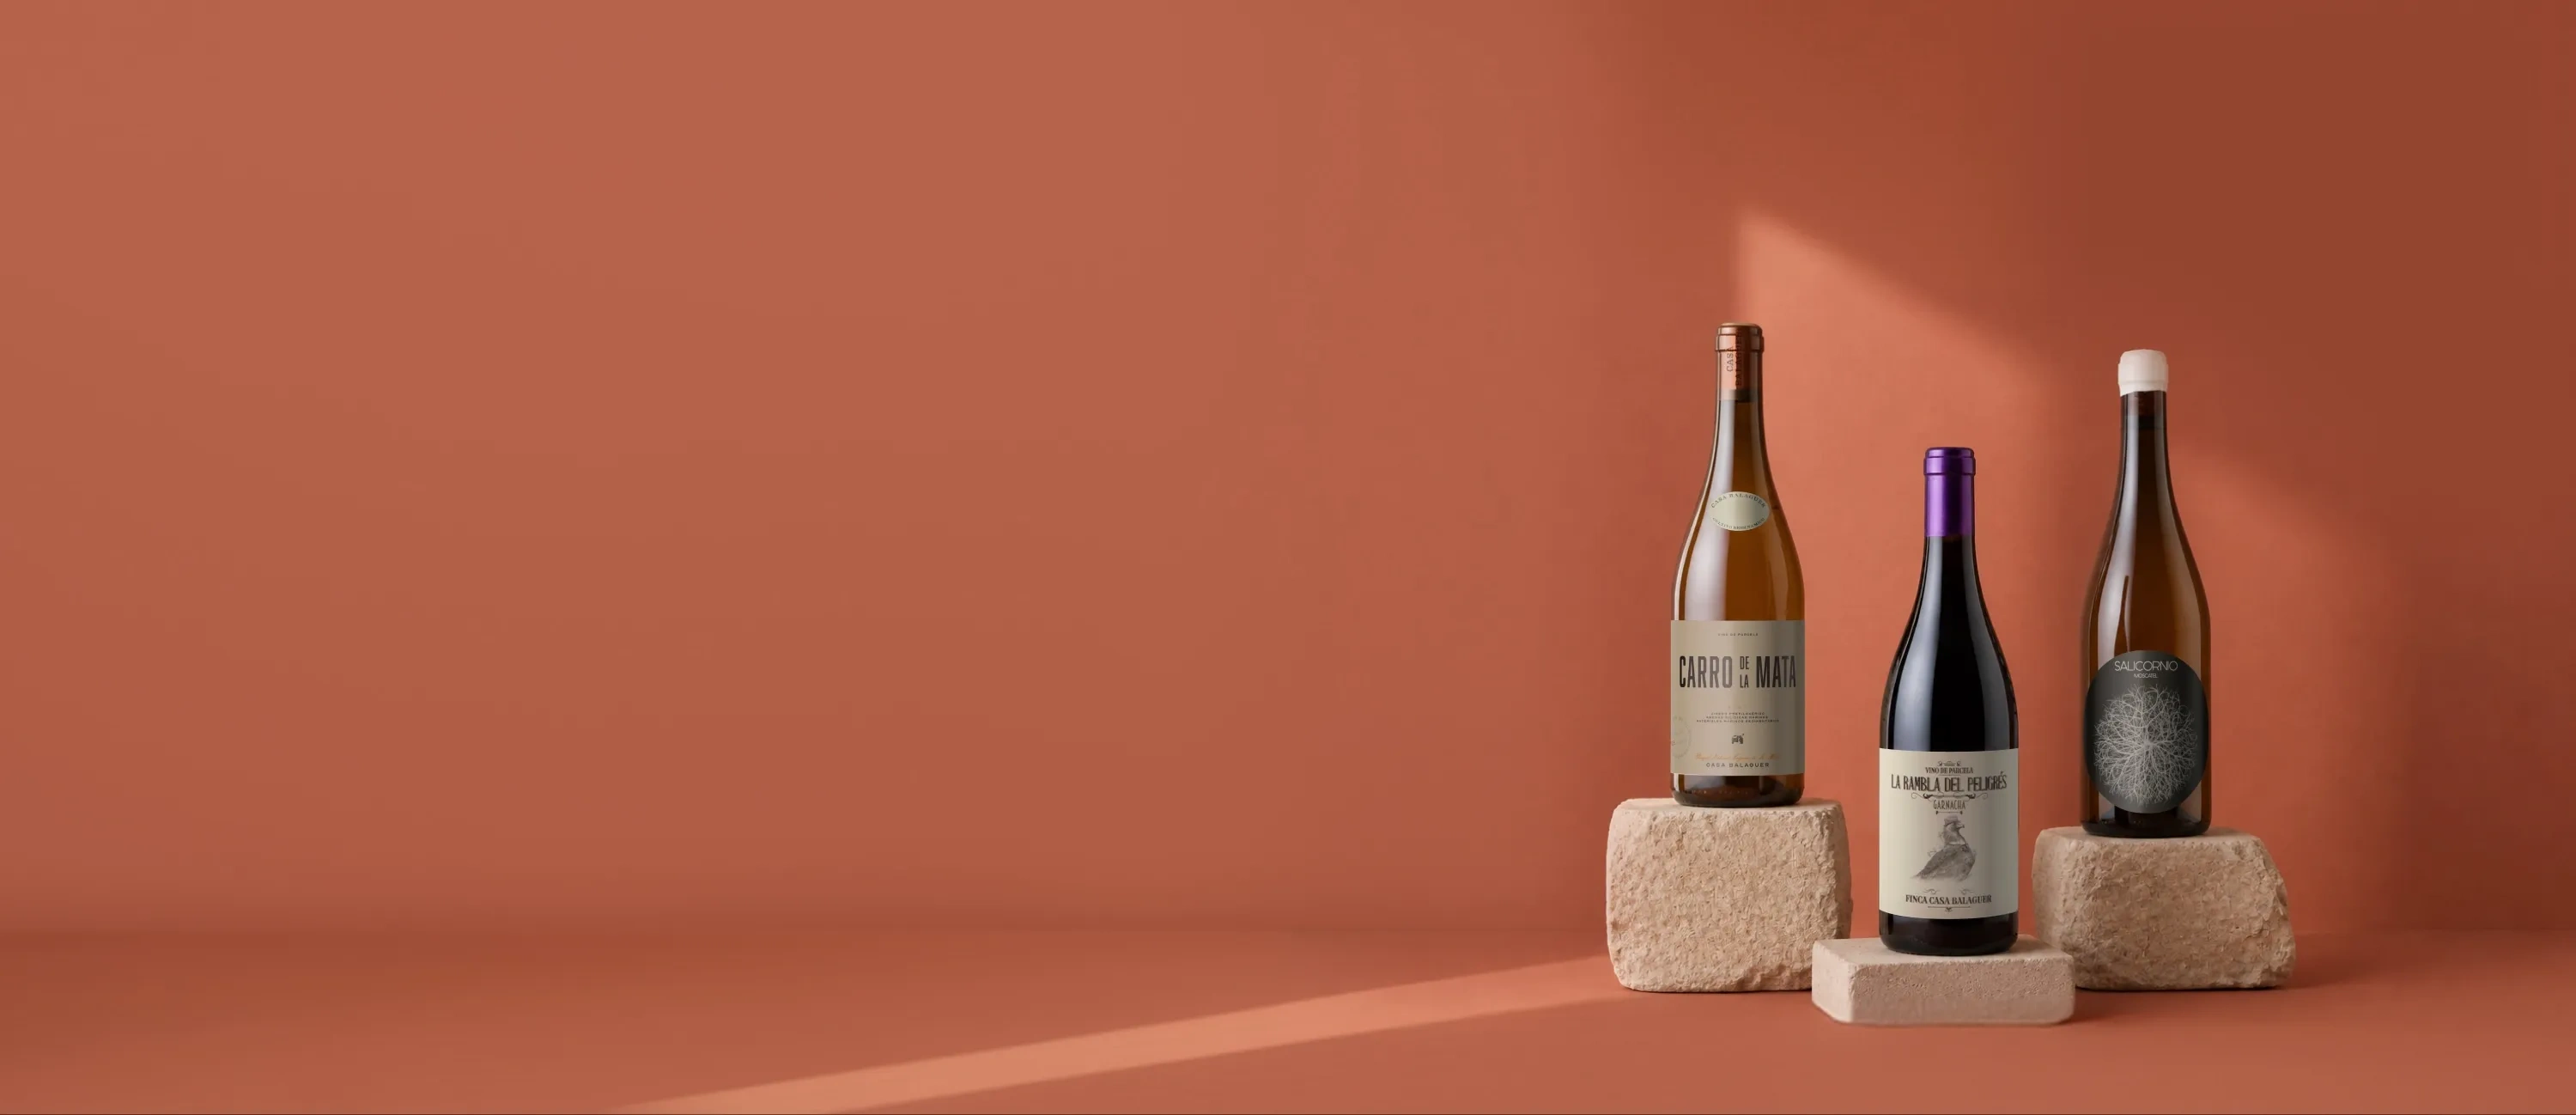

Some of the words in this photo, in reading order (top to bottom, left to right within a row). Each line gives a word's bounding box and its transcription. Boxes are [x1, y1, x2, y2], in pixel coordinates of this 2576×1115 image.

[1710, 495, 1727, 509] CASA
[1728, 493, 1766, 509] BALAGUER
[1740, 655, 1750, 670] DE
[2114, 661, 2178, 672] SALICORNIO
[1679, 655, 1733, 688] CARRO
[1756, 655, 1796, 688] MATA
[1740, 674, 1749, 688] LA
[1891, 774, 1901, 789] LA
[1903, 776, 1941, 792] RAMBLA
[1944, 777, 1965, 792] DEL
[1967, 771, 2008, 792] PELIGRÉS
[1933, 800, 1966, 810] GARNACHA
[1905, 894, 1929, 905] FINCA
[1929, 896, 1951, 905] CASA
[1952, 894, 1992, 905] BALAGUER
